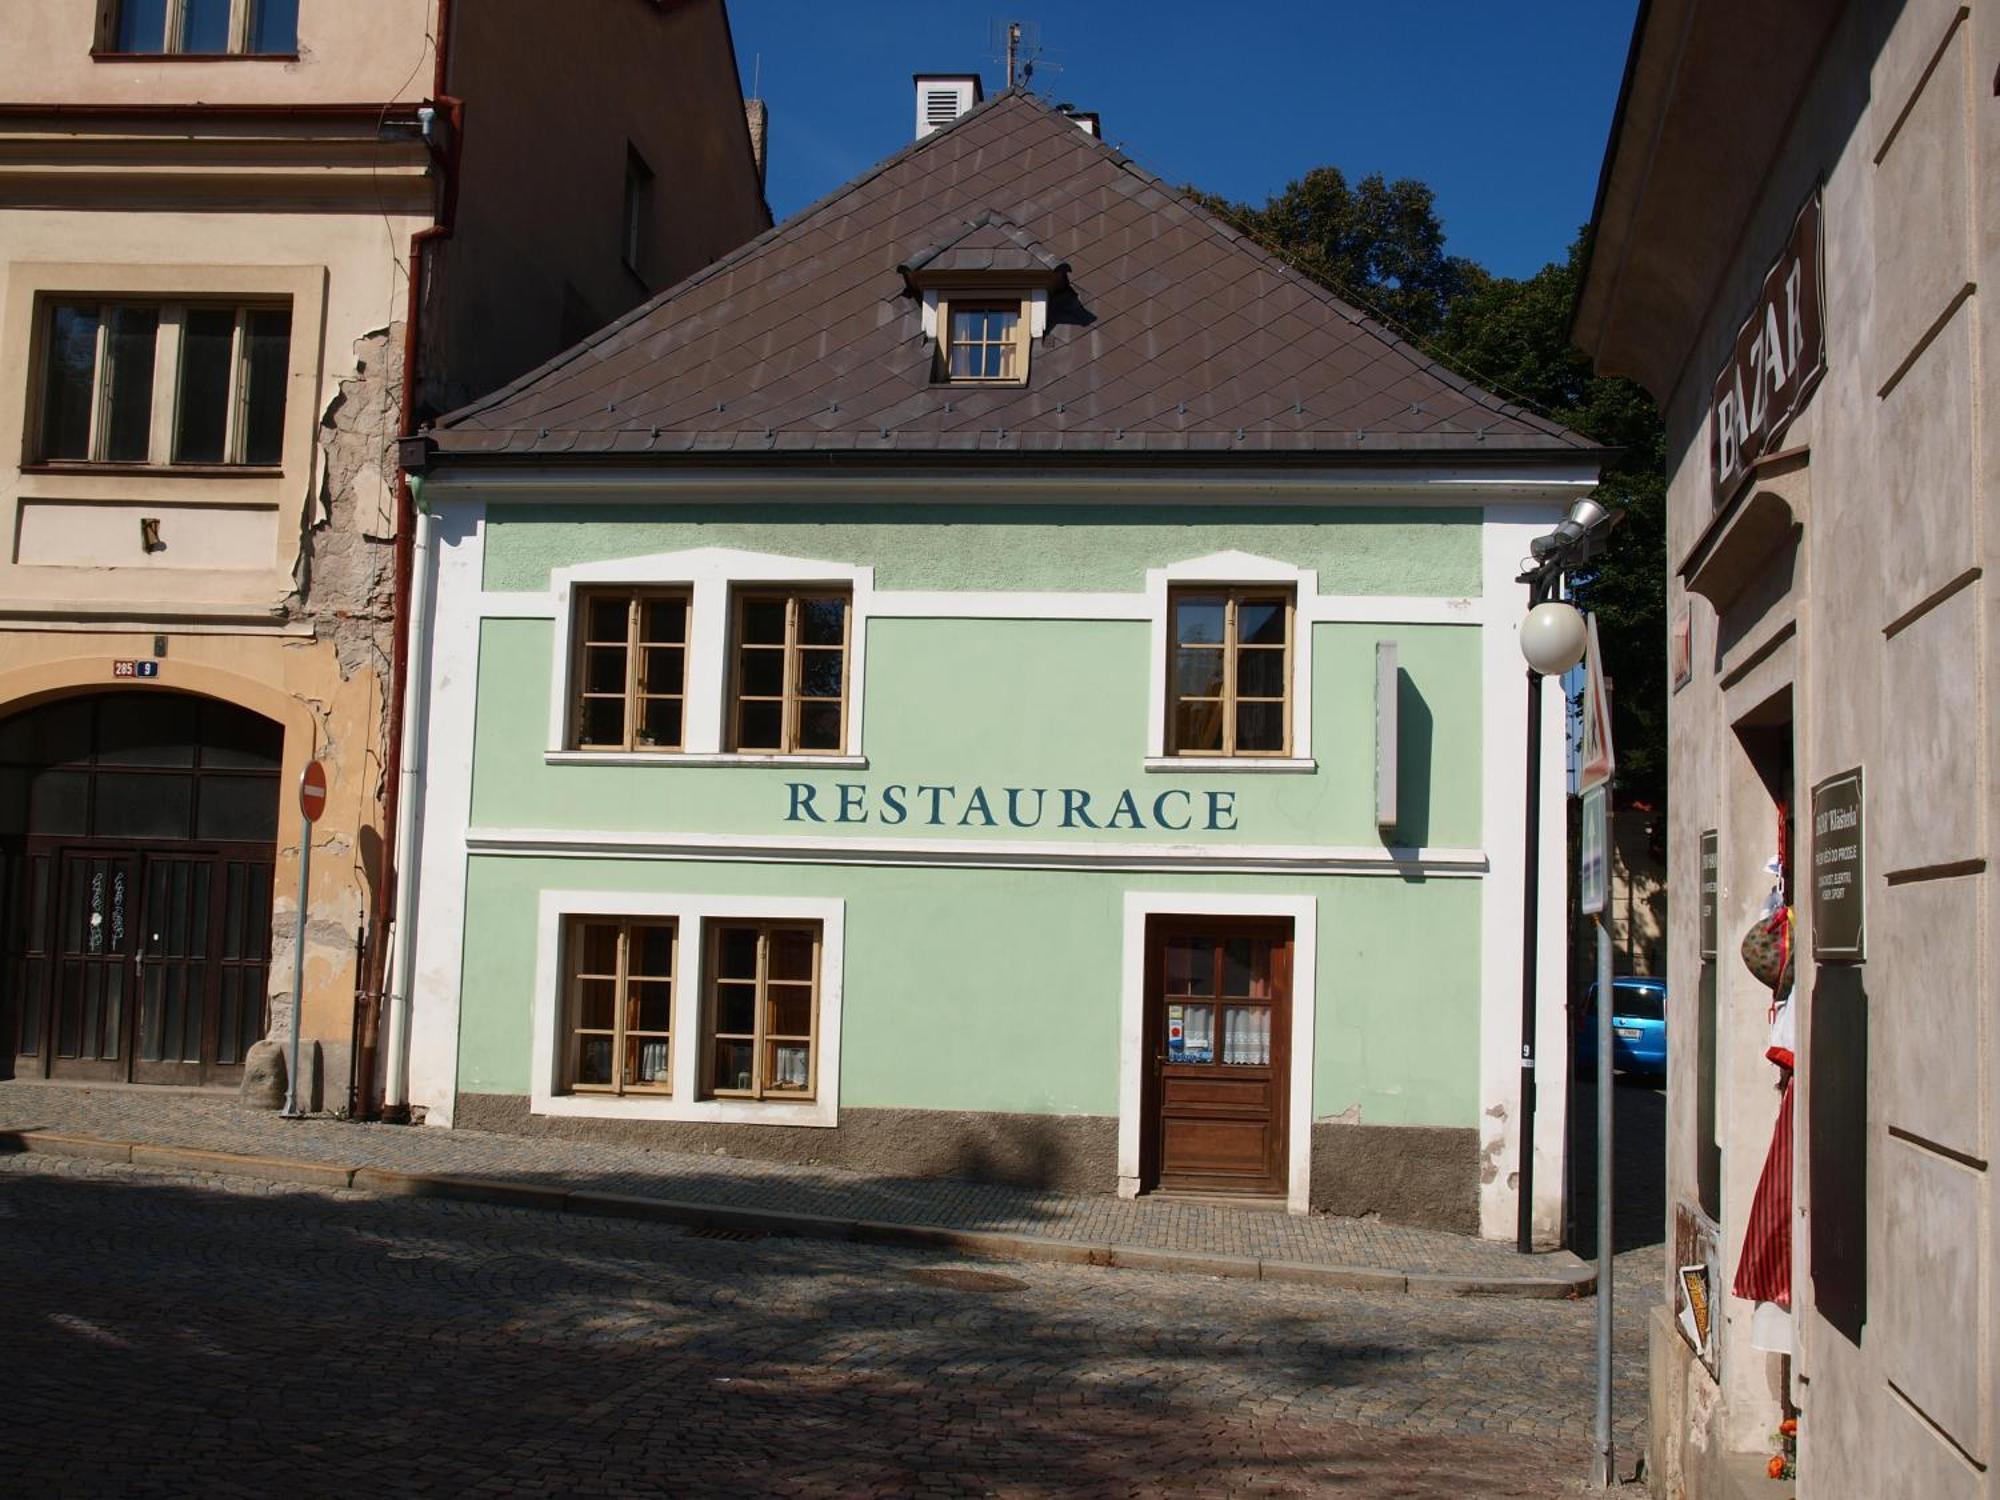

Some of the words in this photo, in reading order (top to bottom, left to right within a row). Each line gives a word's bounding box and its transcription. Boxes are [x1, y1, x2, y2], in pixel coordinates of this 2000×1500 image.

[1718, 257, 1803, 484] BAZAR
[115, 662, 133, 675] 285
[144, 662, 151, 675] 9
[783, 783, 1239, 831] RESTAURACE
[1523, 1044, 1530, 1057] 9
